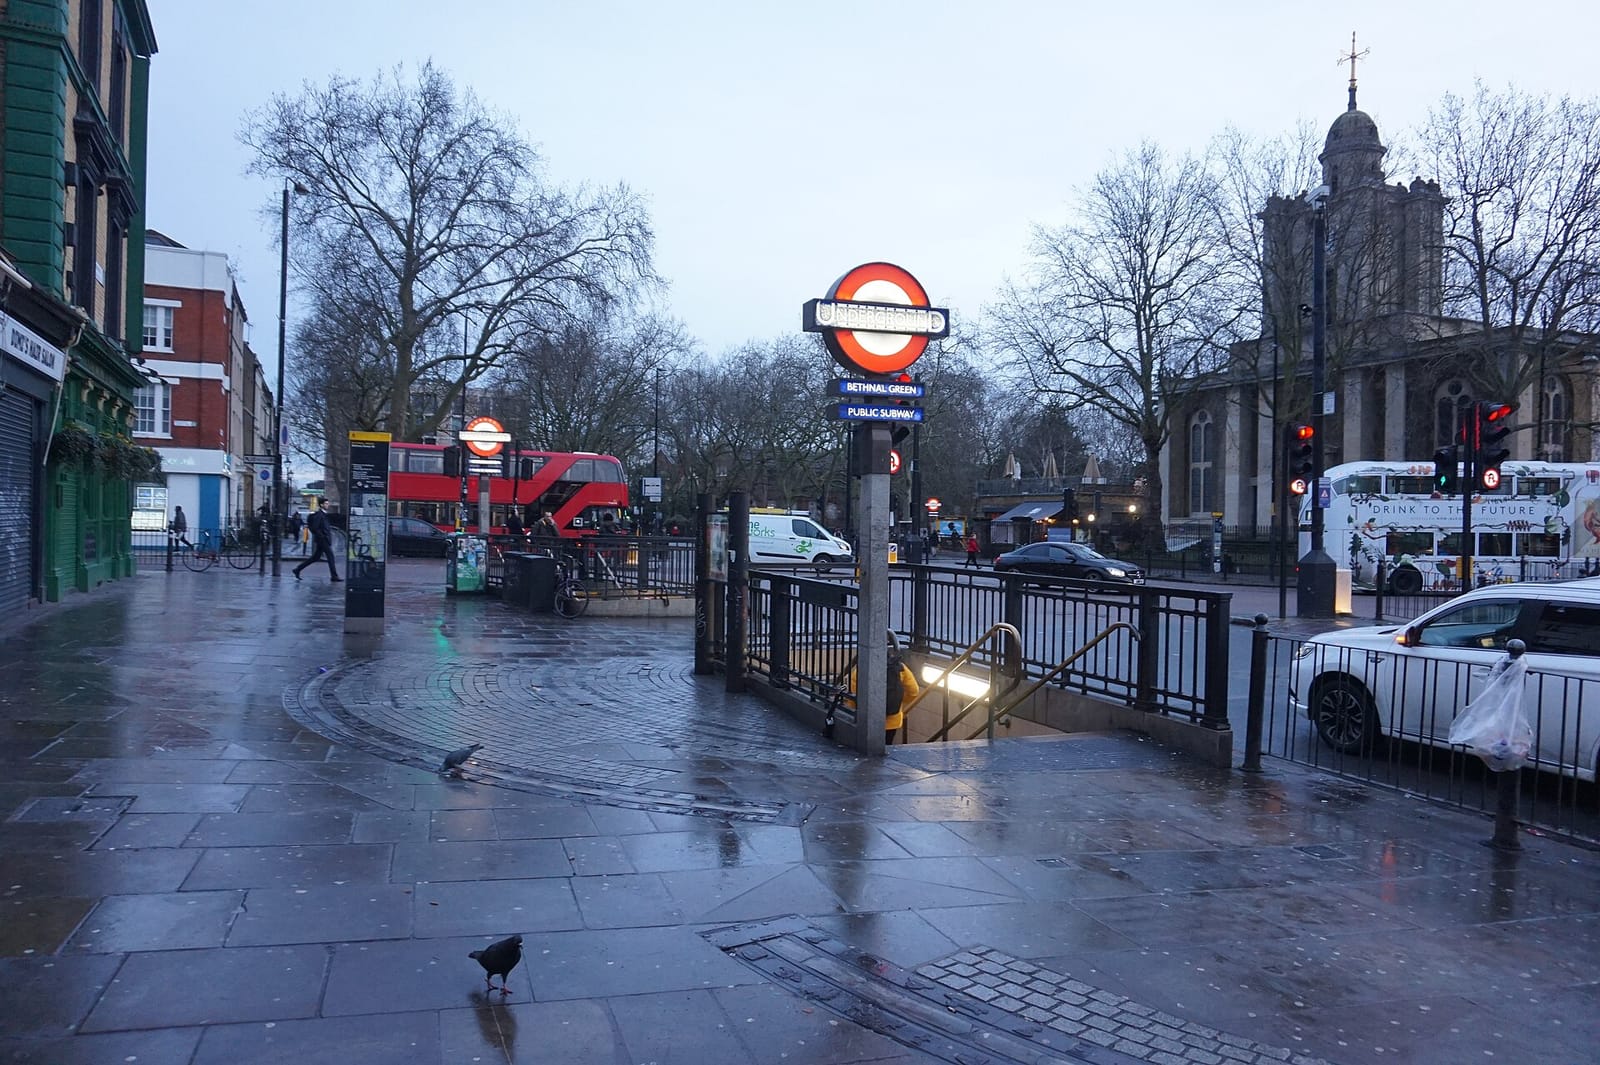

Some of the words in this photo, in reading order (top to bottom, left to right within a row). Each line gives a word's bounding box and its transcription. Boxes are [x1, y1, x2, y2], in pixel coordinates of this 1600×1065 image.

[816, 301, 946, 333] UNDERGROUND
[846, 382, 887, 394] BETHNAL
[888, 384, 917, 394] GREEN
[847, 407, 879, 417] PUBLIC
[880, 408, 915, 418] SUBWAY
[1373, 505, 1416, 514] DRINK
[1424, 505, 1440, 514] TO
[1448, 505, 1464, 514] TH
[1481, 505, 1535, 515] FUTURE
